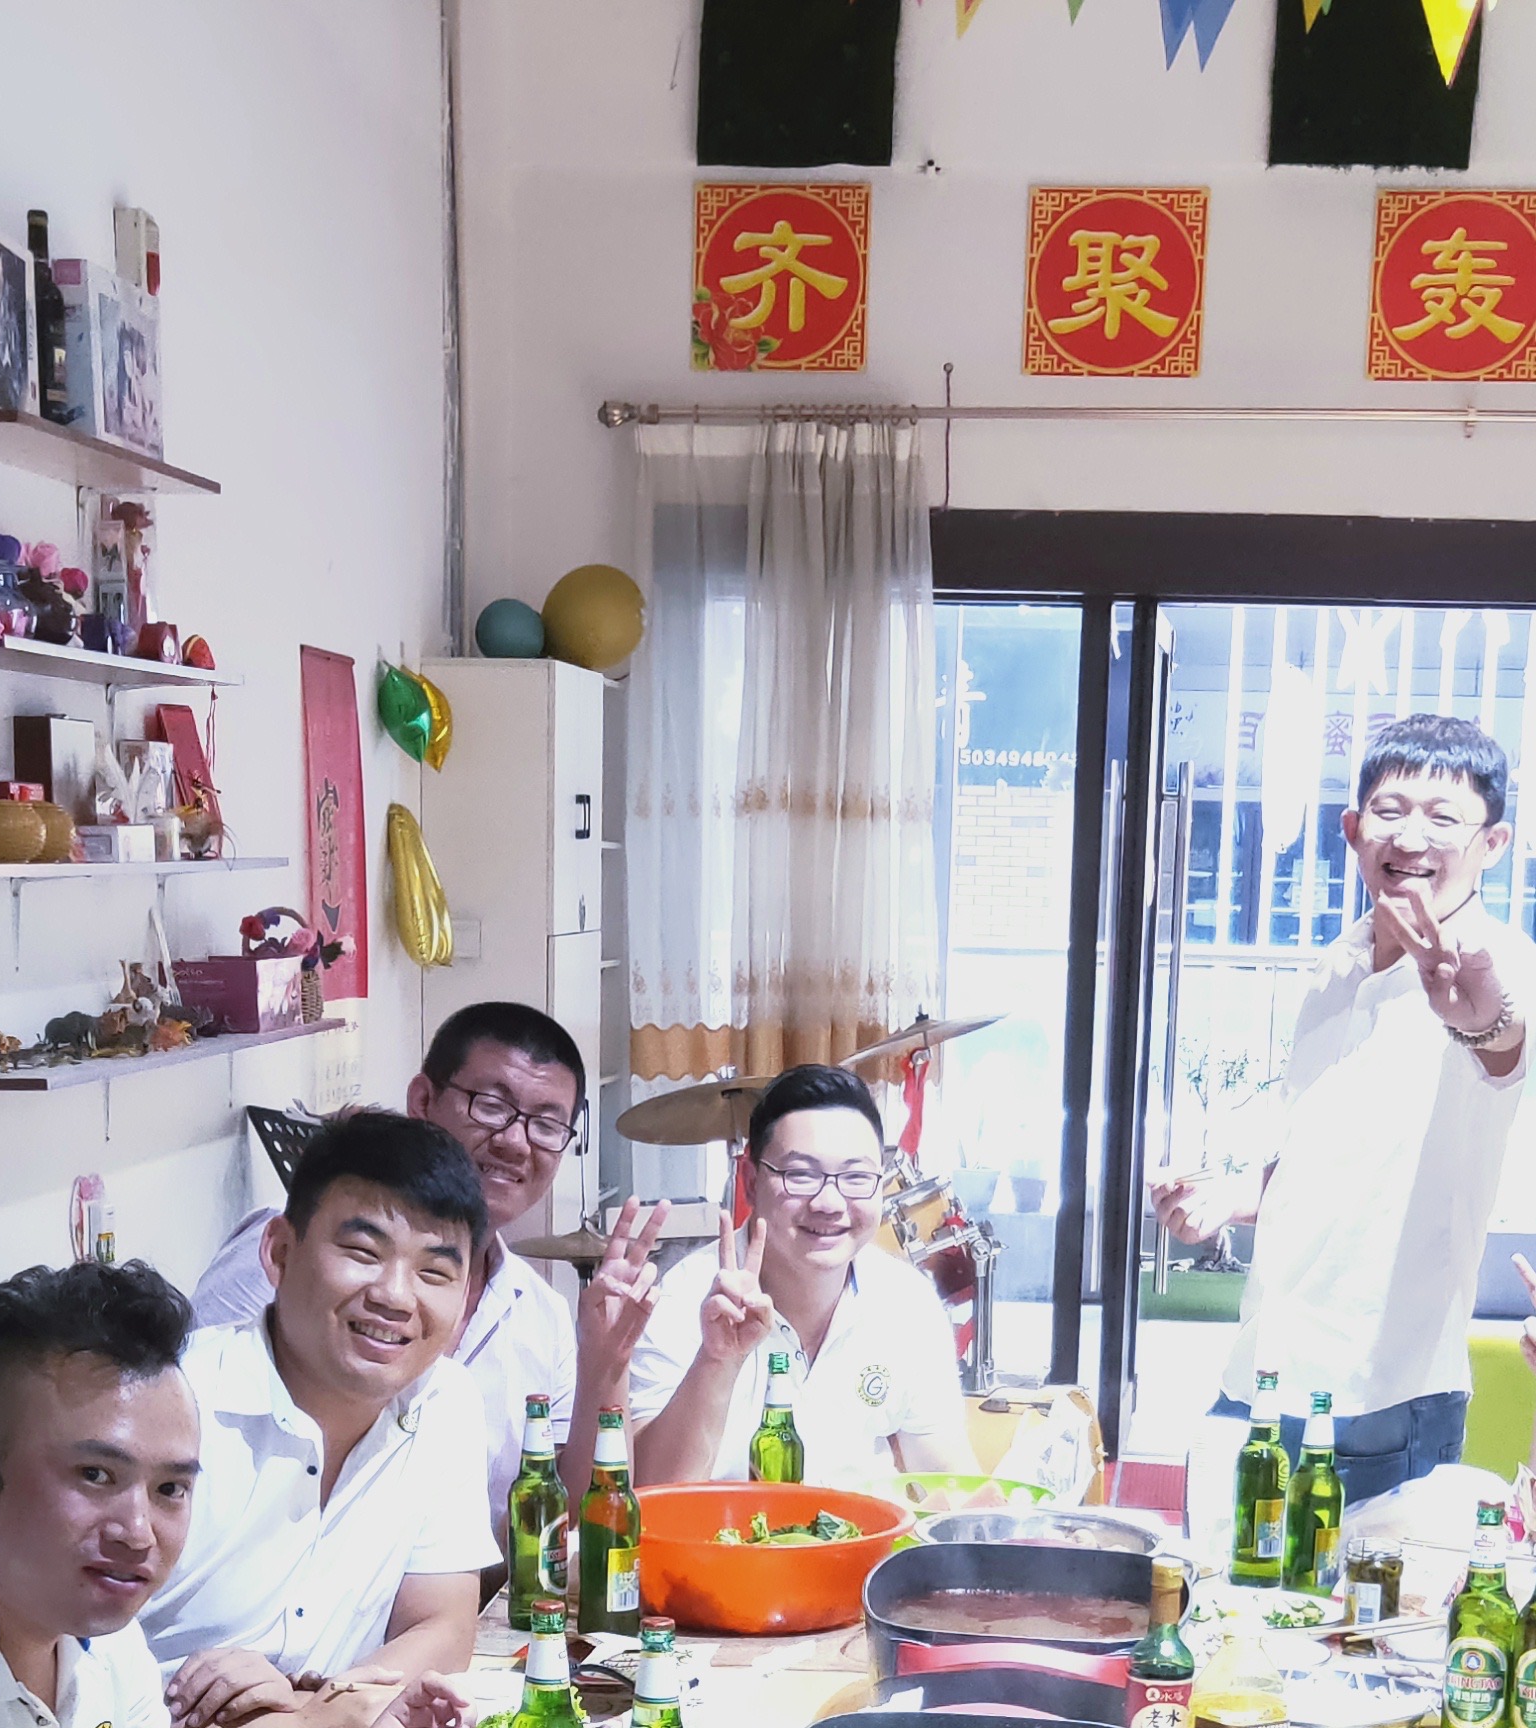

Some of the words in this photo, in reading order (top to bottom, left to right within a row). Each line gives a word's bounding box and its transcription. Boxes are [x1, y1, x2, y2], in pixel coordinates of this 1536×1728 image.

[719, 219, 848, 332] 齐
[1046, 229, 1179, 340] 聚
[1392, 228, 1526, 345] 轰
